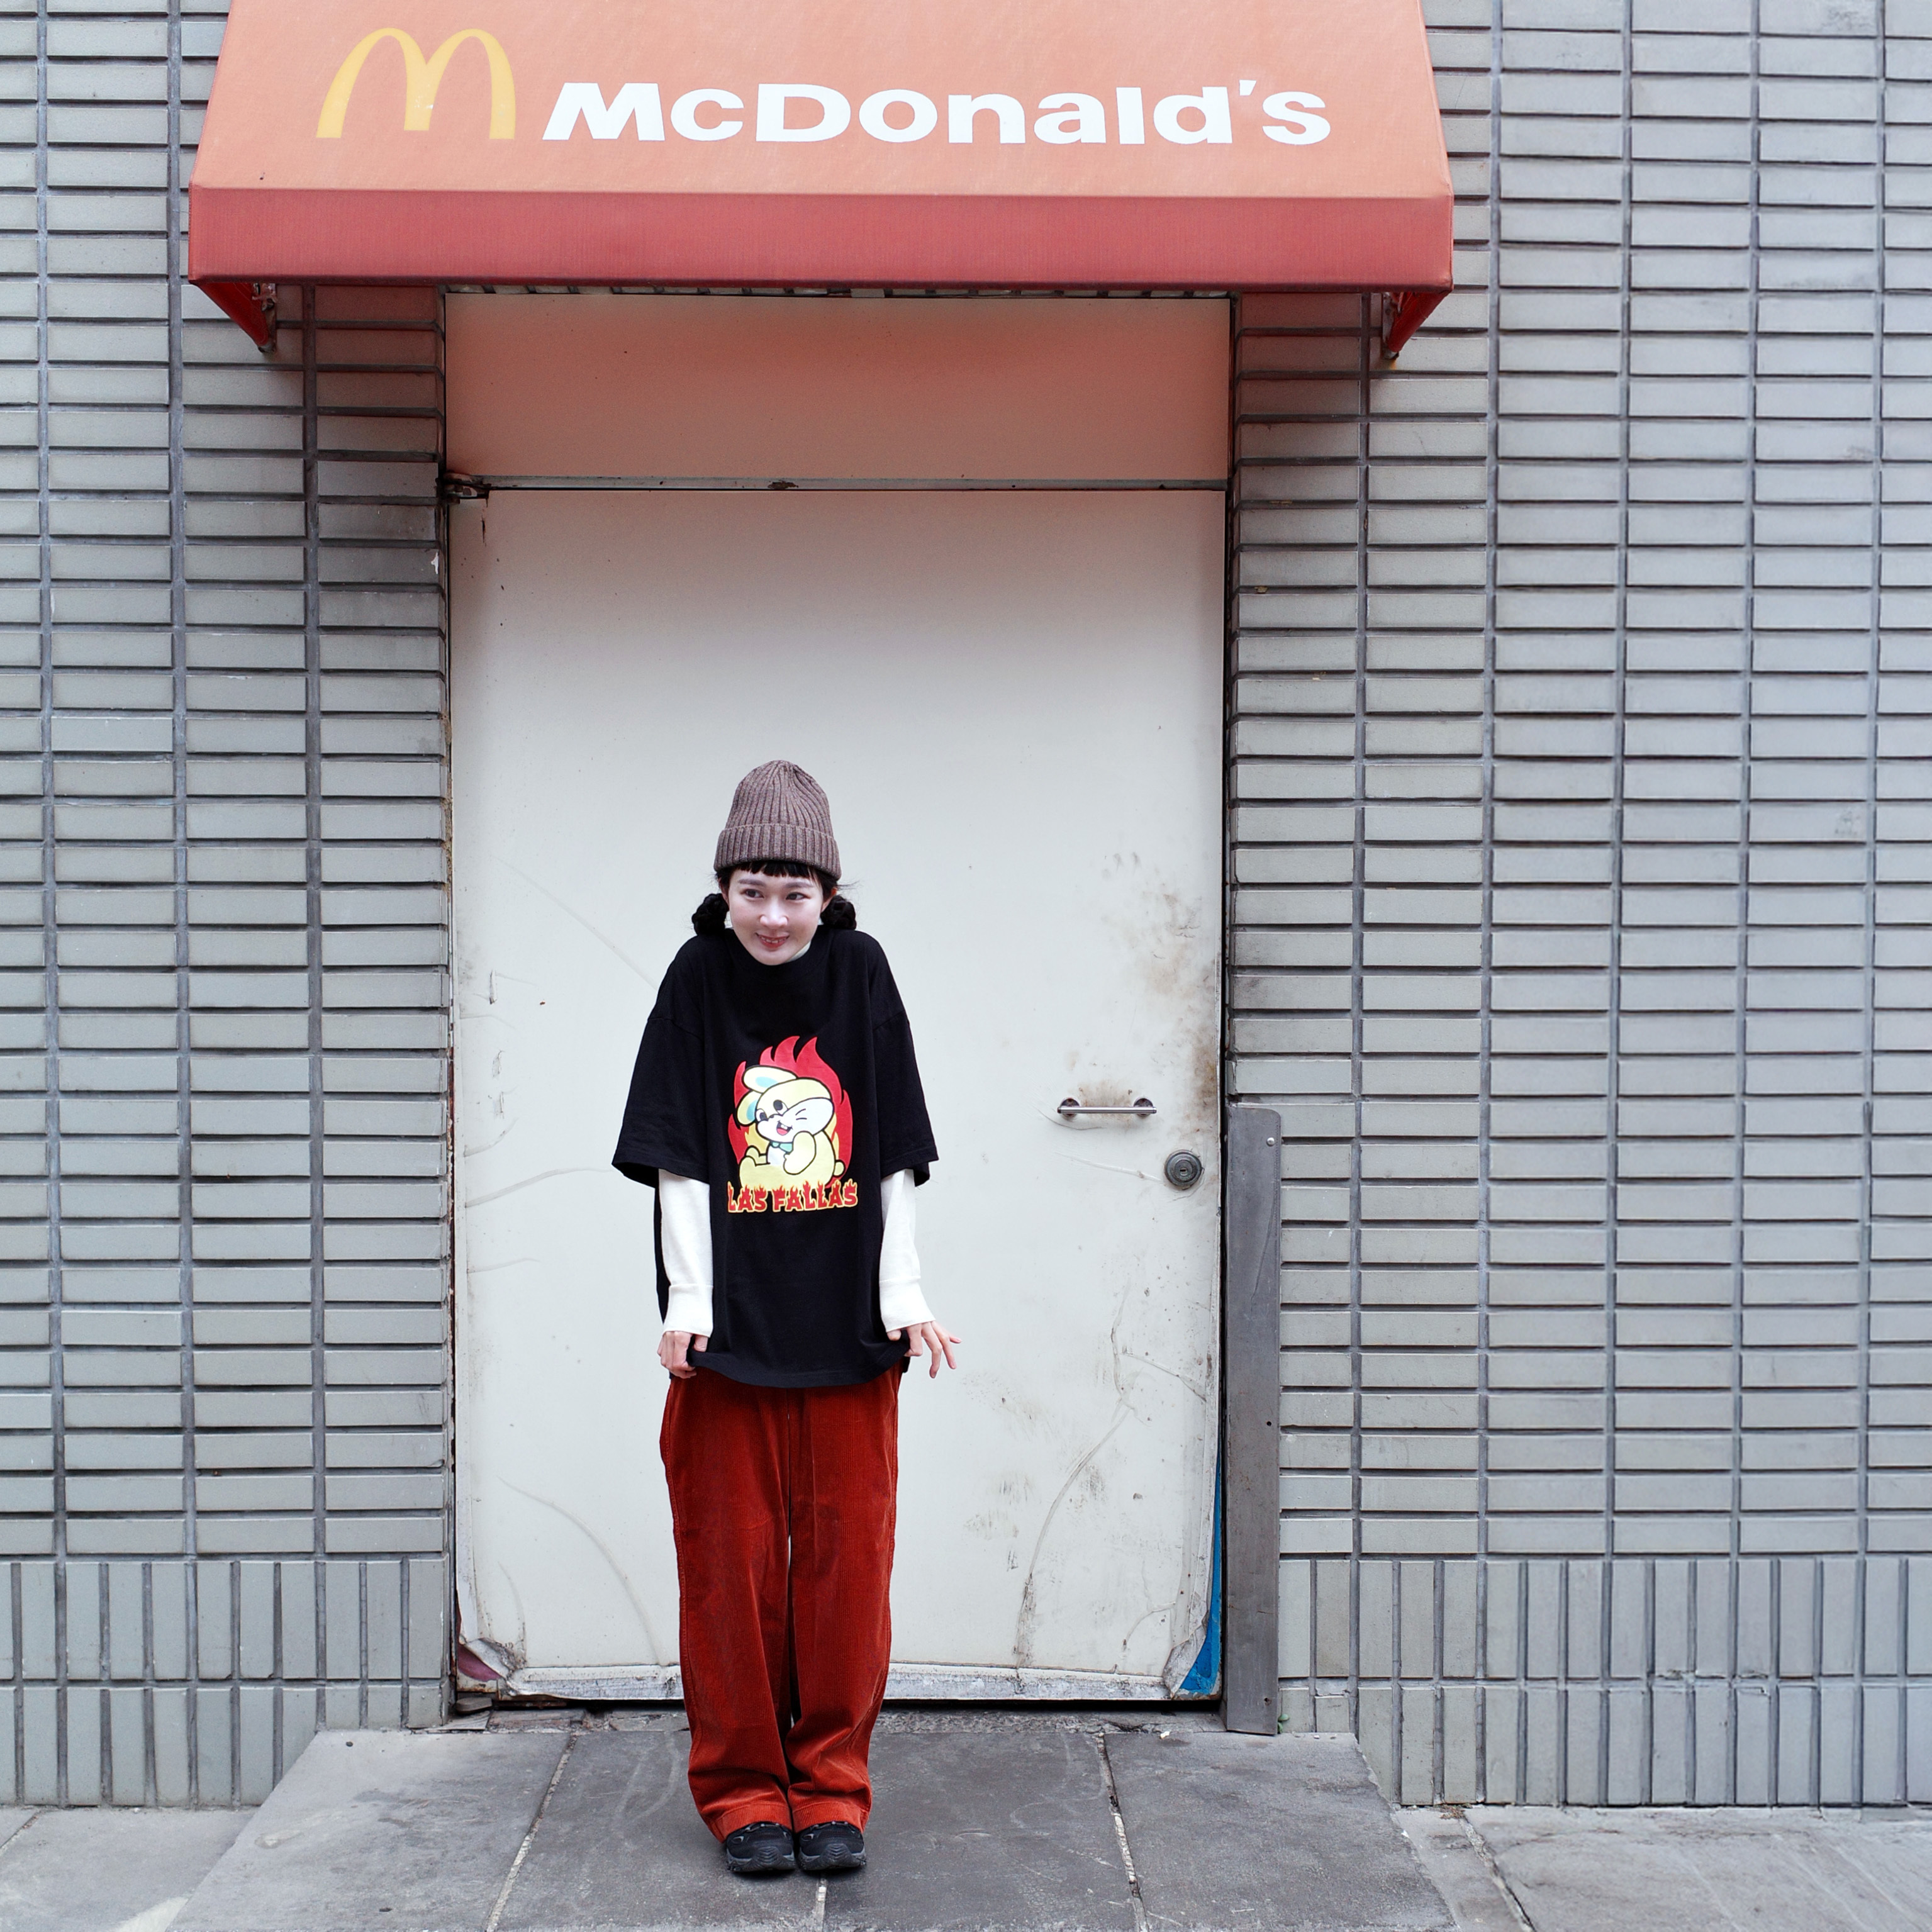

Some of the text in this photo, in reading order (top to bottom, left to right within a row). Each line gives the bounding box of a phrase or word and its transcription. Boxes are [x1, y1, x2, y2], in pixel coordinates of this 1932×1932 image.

[542, 79, 1331, 145] McDonald's
[727, 1178, 858, 1212] LAS FALLAS
